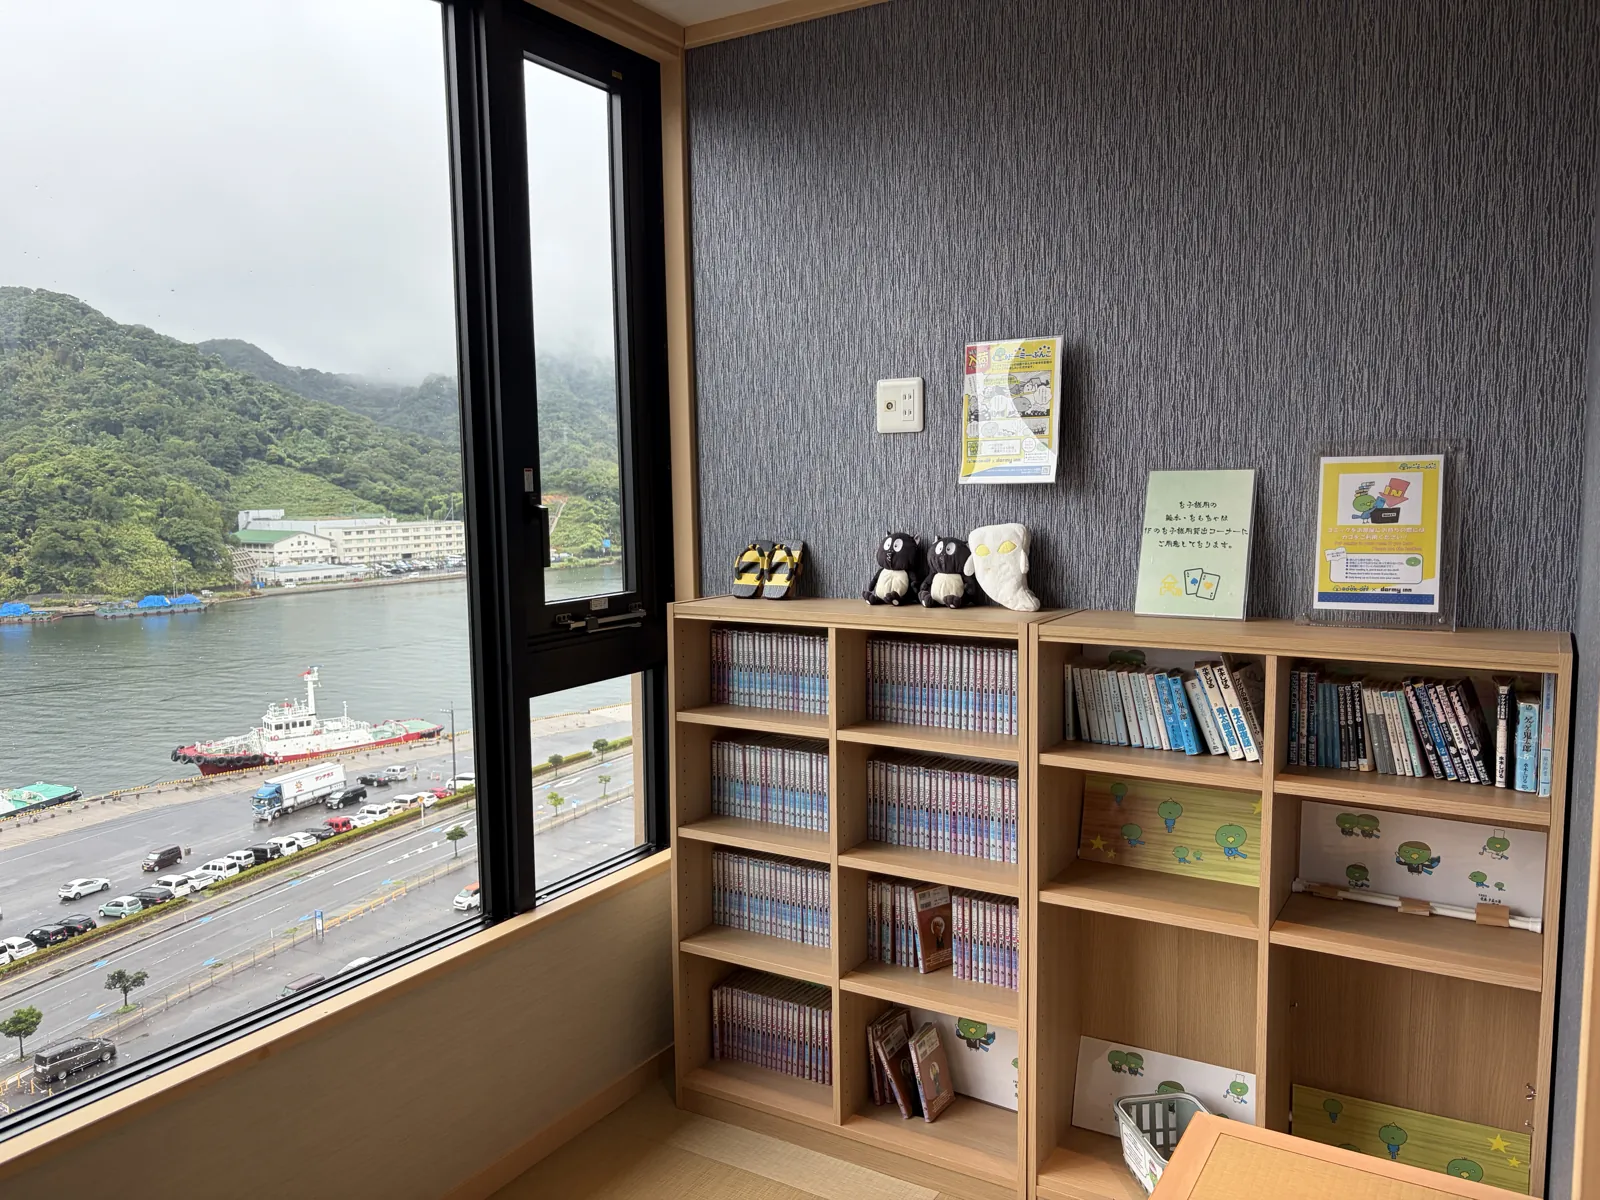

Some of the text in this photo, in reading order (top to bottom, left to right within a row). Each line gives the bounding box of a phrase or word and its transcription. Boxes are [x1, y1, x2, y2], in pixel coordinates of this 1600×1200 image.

[1384, 486, 1402, 497] IN
[1179, 501, 1217, 509] お子様用の
[1166, 514, 1228, 522] 絵本・おもちゃは
[1158, 540, 1232, 549] ご用意しております。
[1202, 667, 1214, 689] 水木しげる
[1217, 668, 1230, 689] 水木しげる
